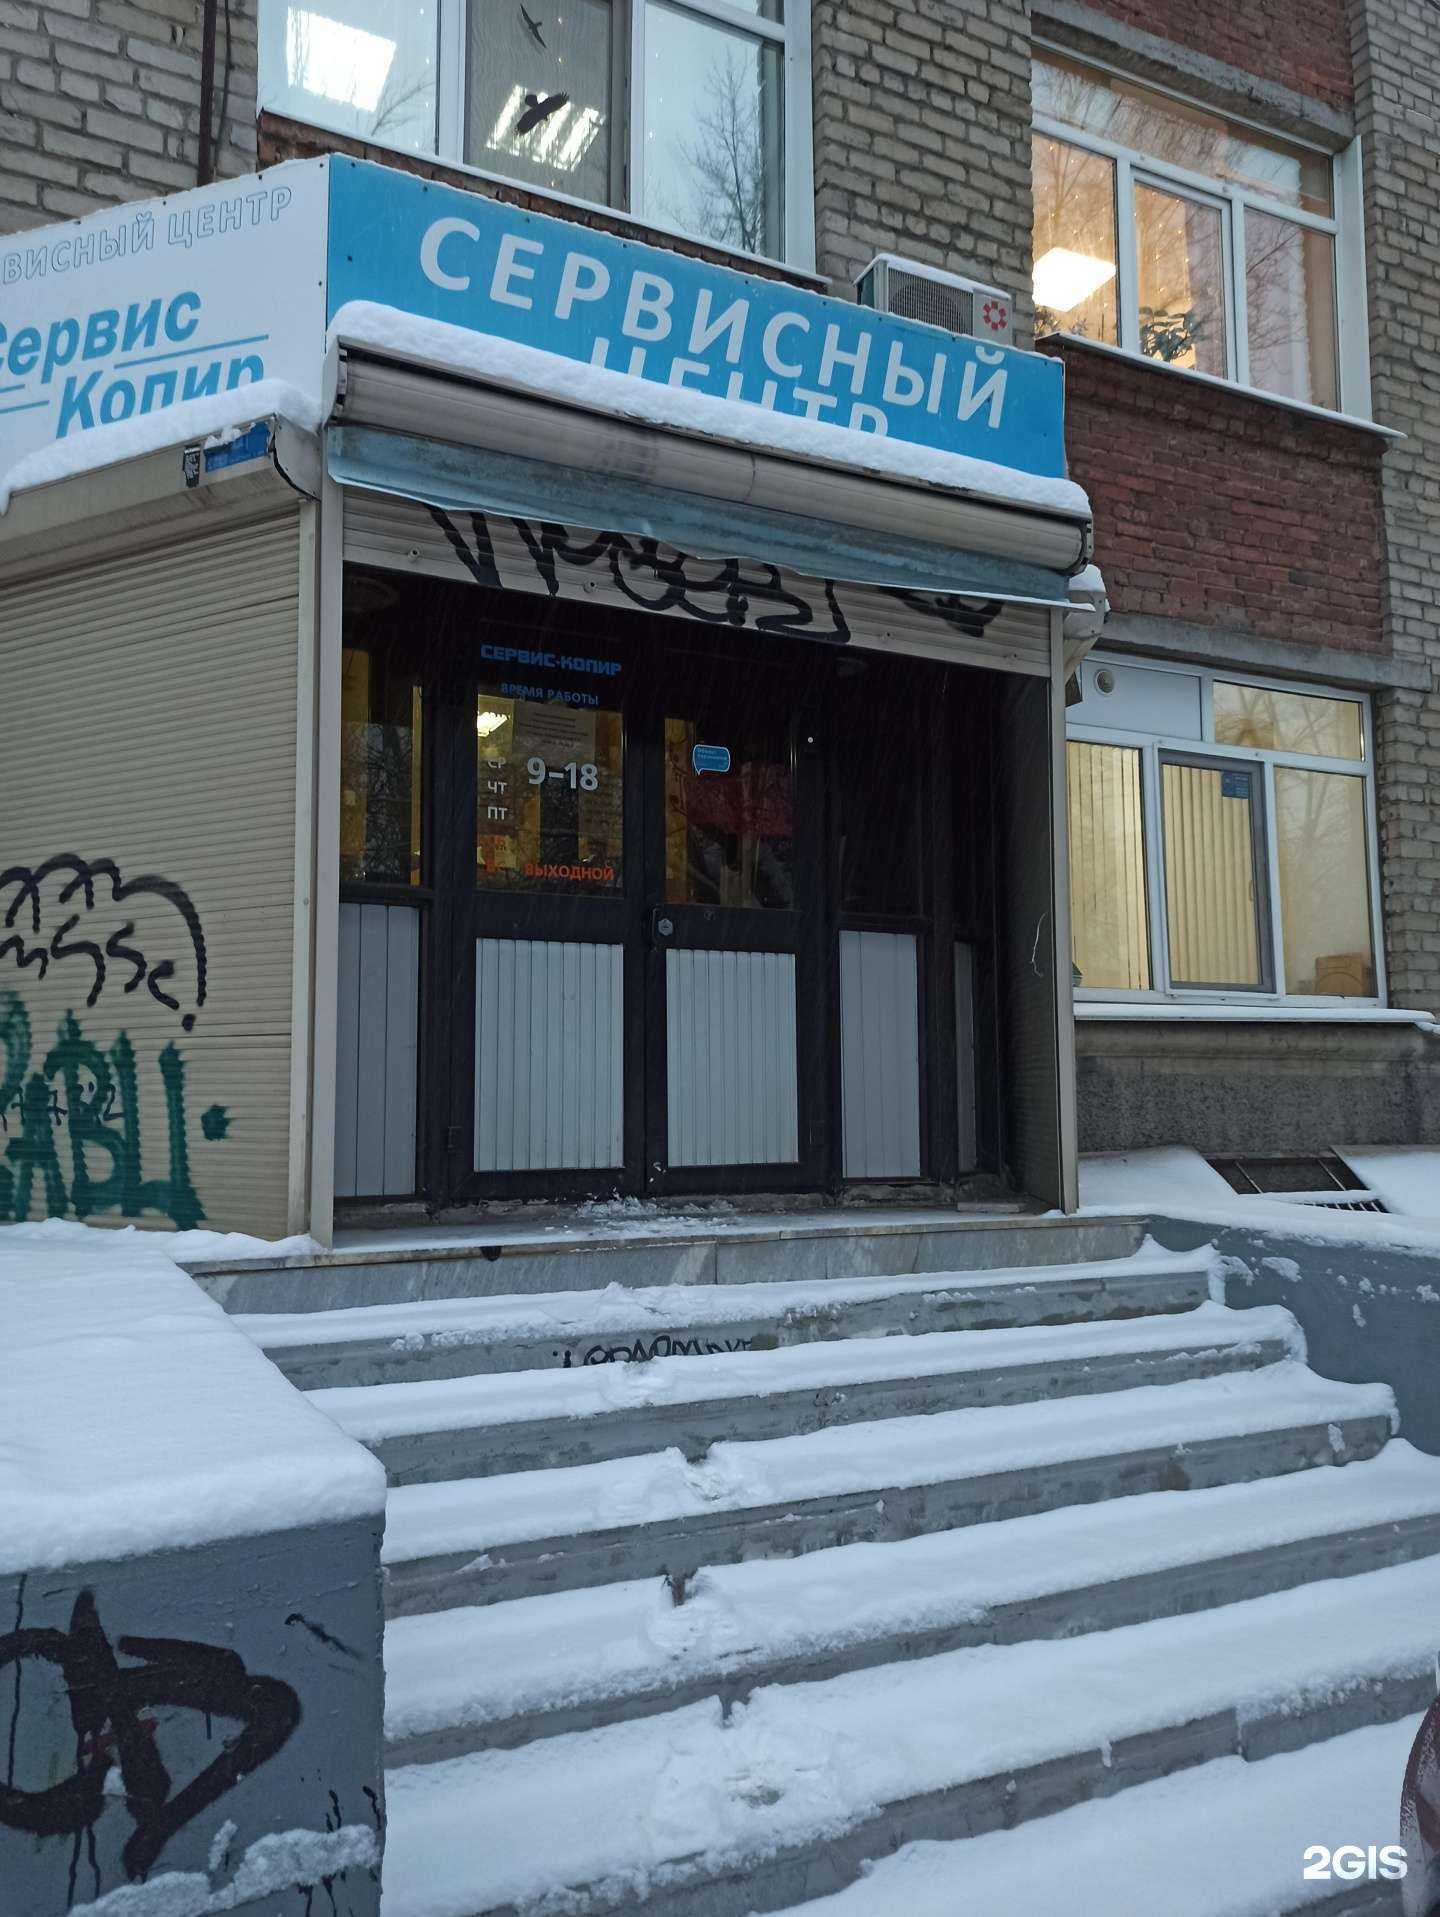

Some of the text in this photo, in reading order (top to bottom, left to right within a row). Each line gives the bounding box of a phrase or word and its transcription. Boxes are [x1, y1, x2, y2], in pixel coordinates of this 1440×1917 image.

[167, 186, 292, 249] ЦЕНТР
[0, 291, 201, 384] ервис
[419, 216, 1009, 429] СЕРВИСНЫЙ
[480, 643, 622, 676] СЕРВИС-КОПИР
[501, 682, 599, 706] ВРЕМЯ РАБОТЫ
[487, 780, 508, 795] ЧТ
[526, 756, 599, 791] 9-18
[487, 805, 508, 820] ПТ
[525, 861, 615, 880] ВЫХОДНОЙ
